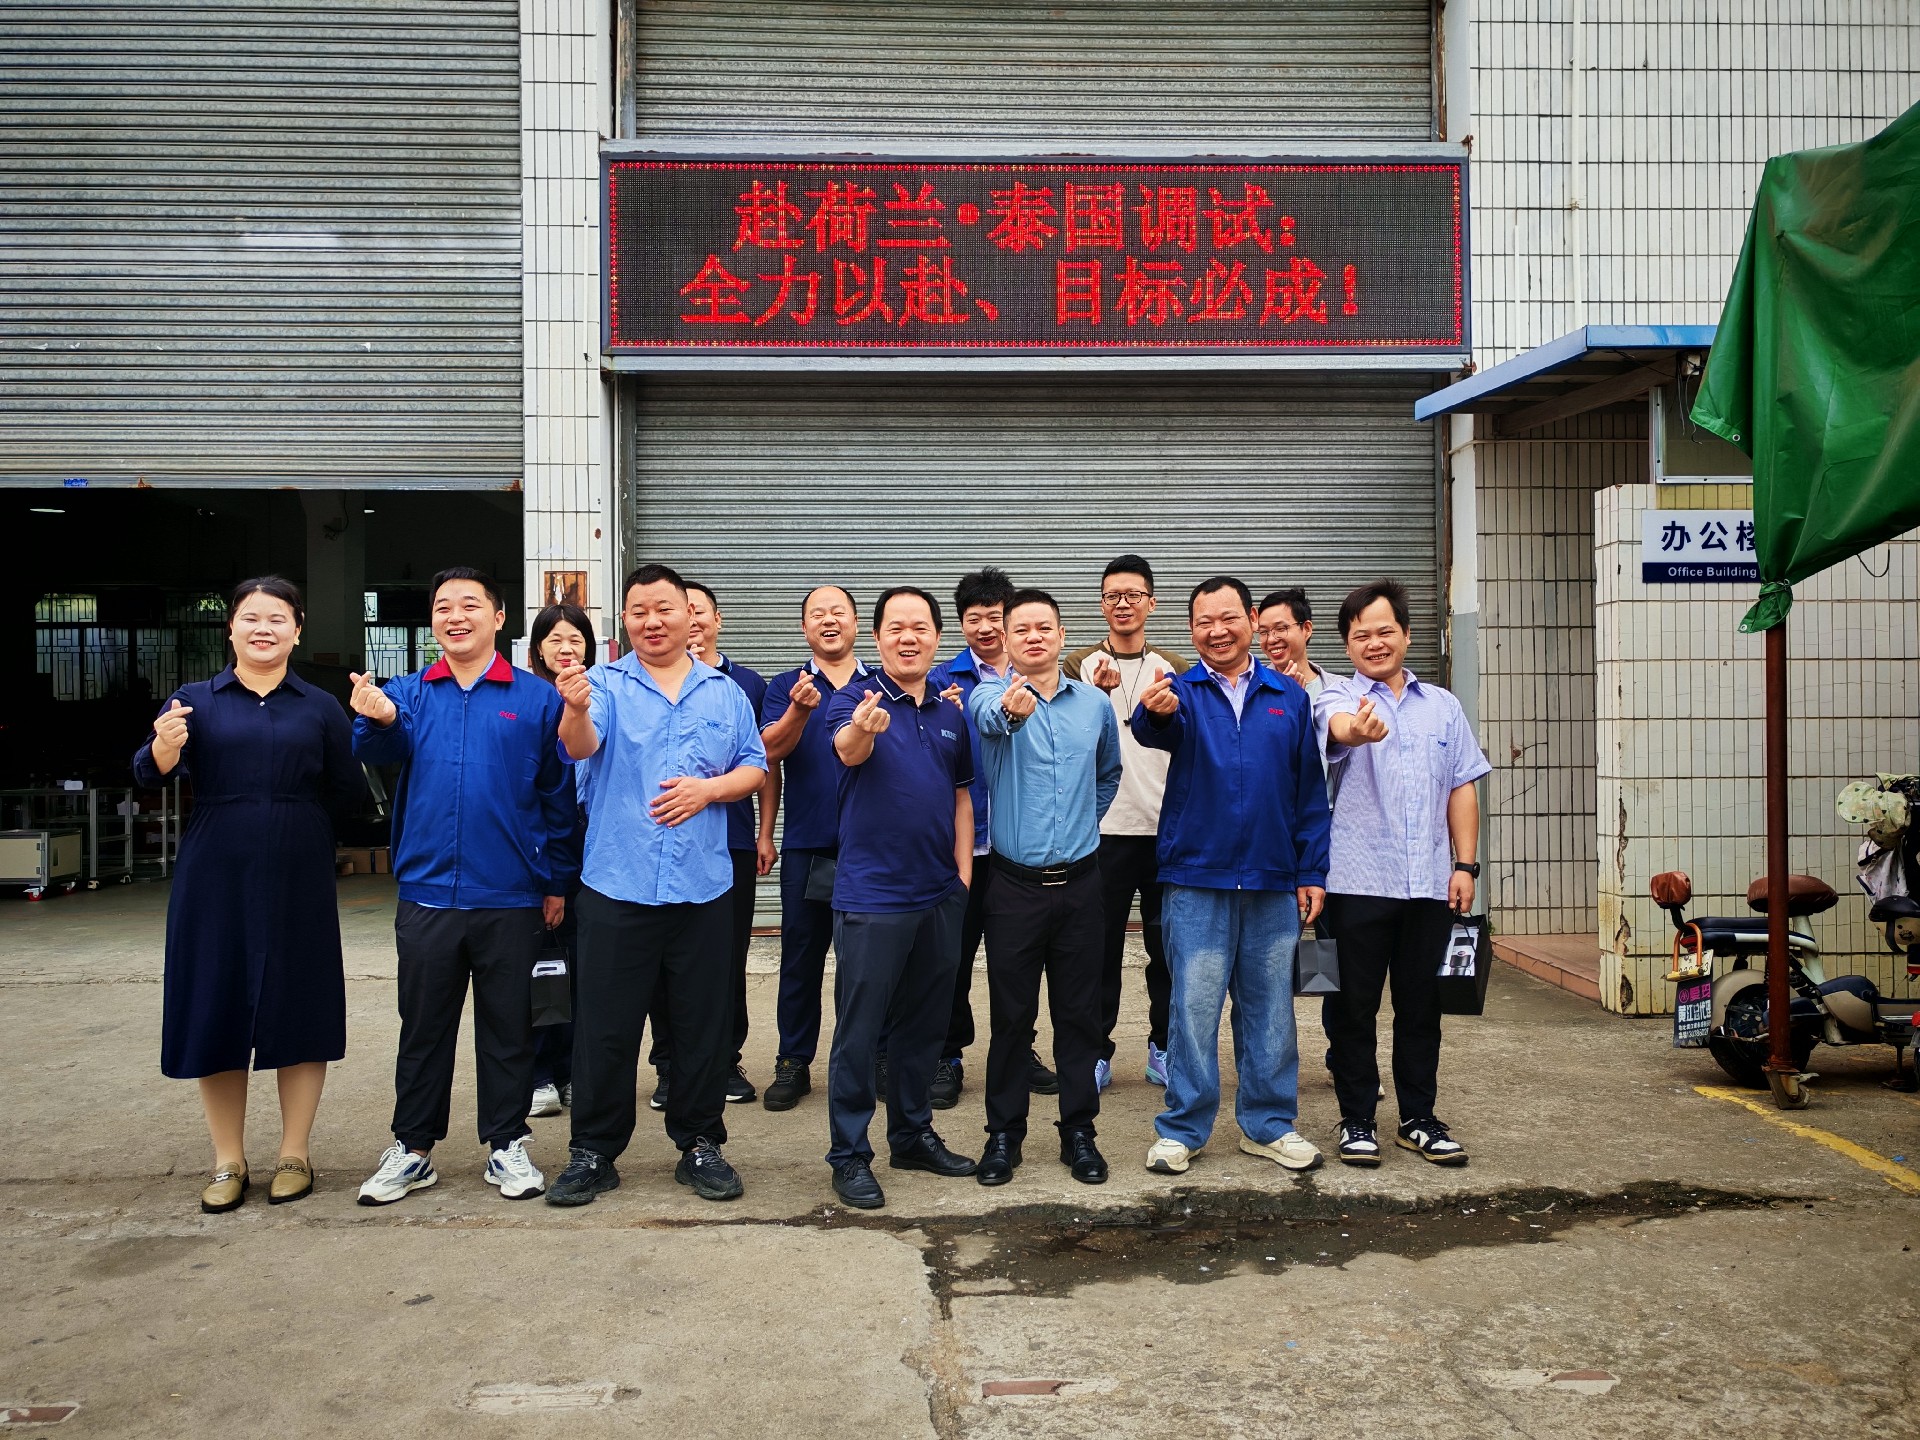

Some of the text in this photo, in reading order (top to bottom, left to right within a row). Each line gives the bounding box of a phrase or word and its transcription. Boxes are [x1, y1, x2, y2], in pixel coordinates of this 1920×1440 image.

[680, 253, 1358, 326] 全力以赴、目标必成！
[1668, 566, 1757, 578] Office Building
